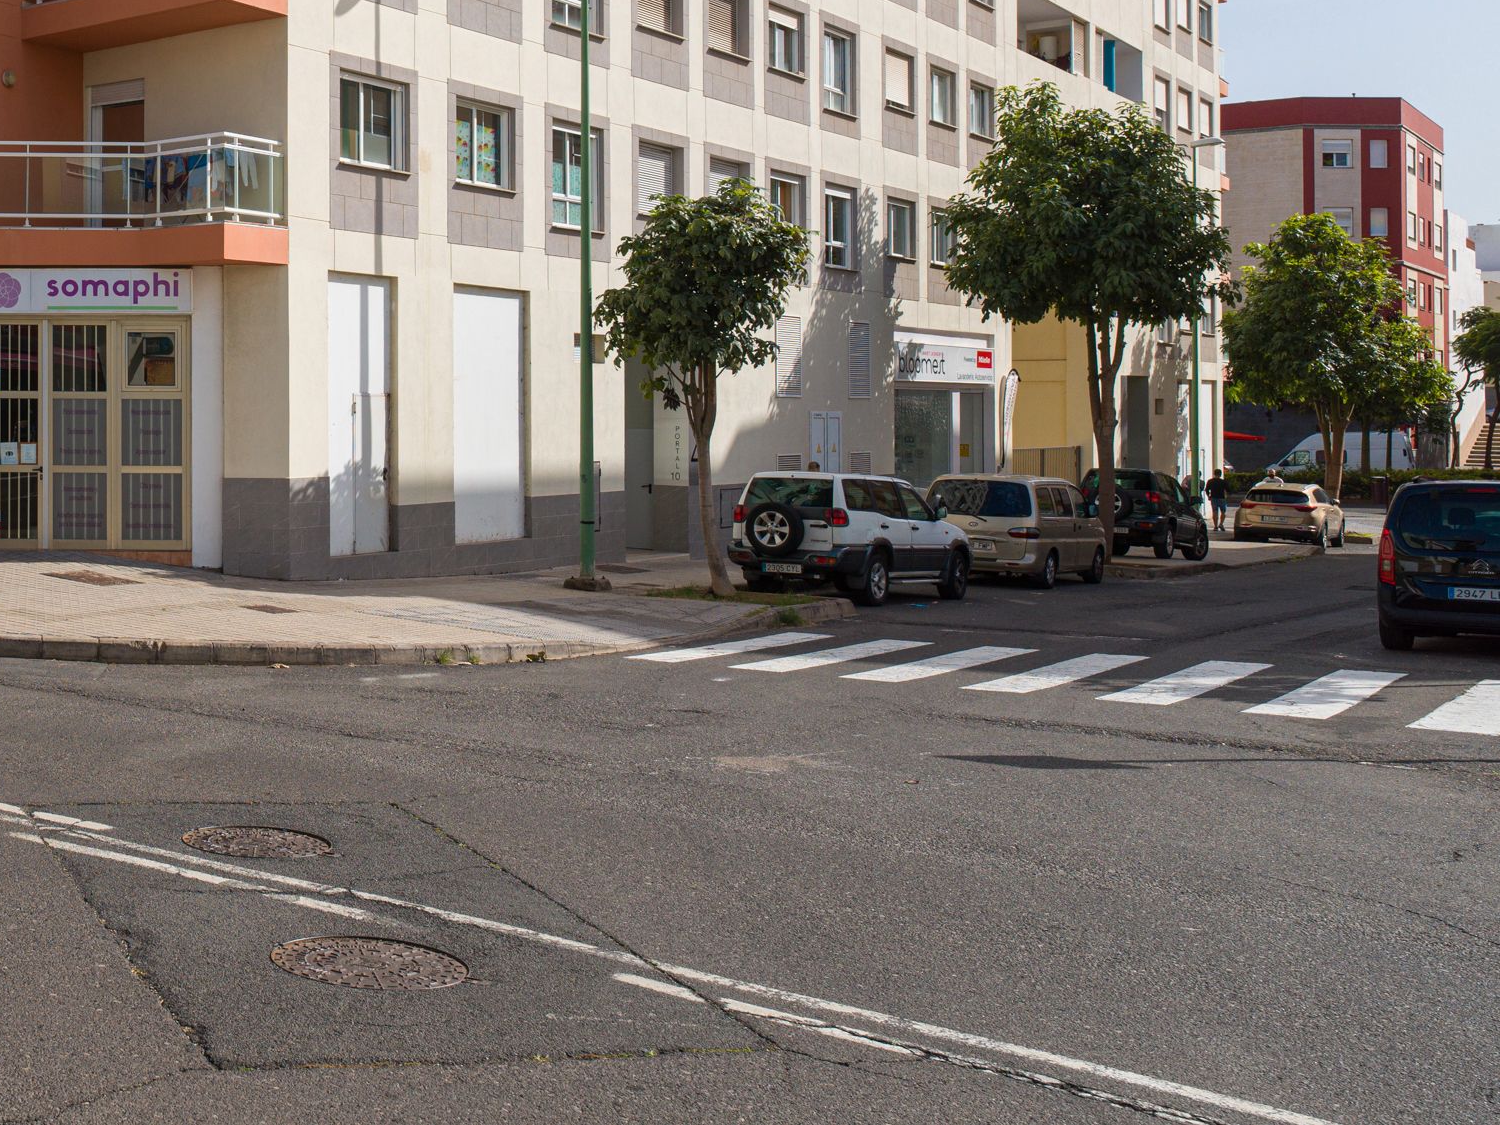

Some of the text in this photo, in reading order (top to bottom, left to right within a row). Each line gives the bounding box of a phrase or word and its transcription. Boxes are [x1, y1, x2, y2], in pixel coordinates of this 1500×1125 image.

[47, 272, 179, 305] somaphi
[670, 472, 681, 481] 10
[1456, 588, 1486, 599] 2947
